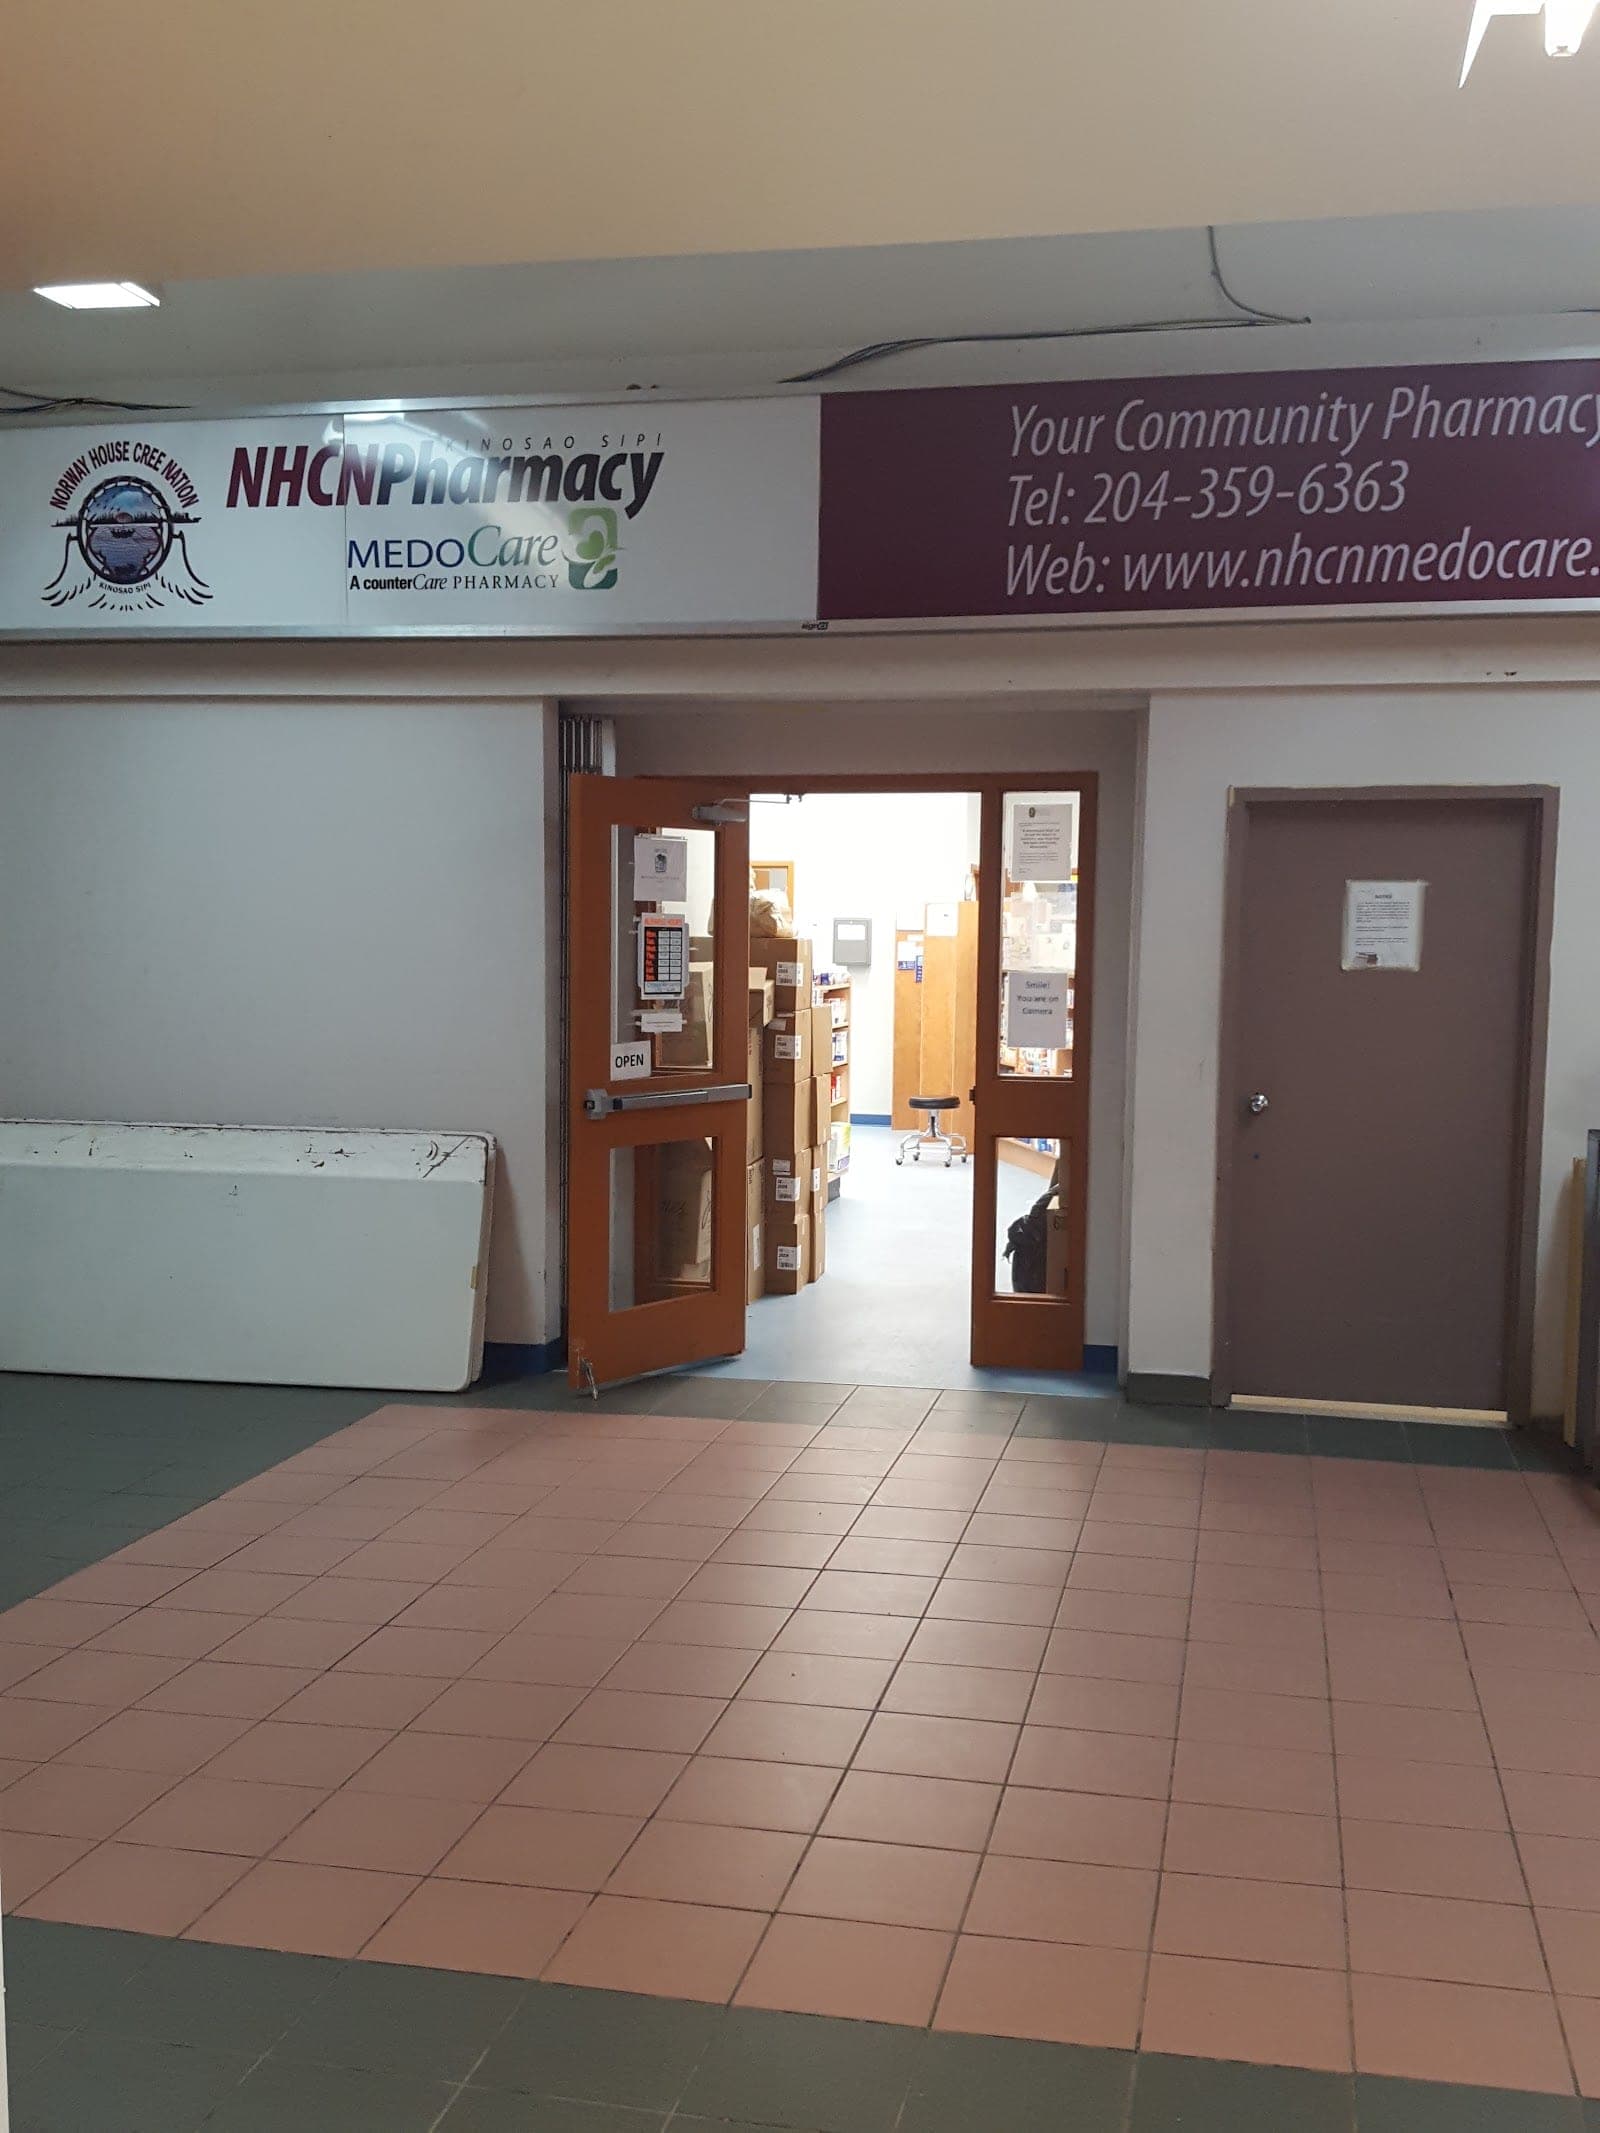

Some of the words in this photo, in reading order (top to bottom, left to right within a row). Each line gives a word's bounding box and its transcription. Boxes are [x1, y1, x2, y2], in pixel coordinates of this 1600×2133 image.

[445, 436, 576, 451] KINOSAO
[601, 432, 662, 448] SIPI
[1011, 404, 1105, 457] Your
[1115, 391, 1374, 457] Community
[50, 456, 91, 511] NORWAY
[88, 441, 130, 469] HOUSE
[133, 442, 166, 472] CREE
[161, 459, 200, 509] NATION
[1008, 472, 1075, 527] Tel:
[1083, 460, 1409, 523] 204-359-6363
[350, 575, 360, 590] A
[453, 574, 559, 590] PHARMACY
[1006, 541, 1110, 597] Web:
[1124, 525, 1600, 592] www.nhcnmedocare.
[1022, 1007, 1053, 1015] Camera
[615, 1054, 644, 1068] OPEN
